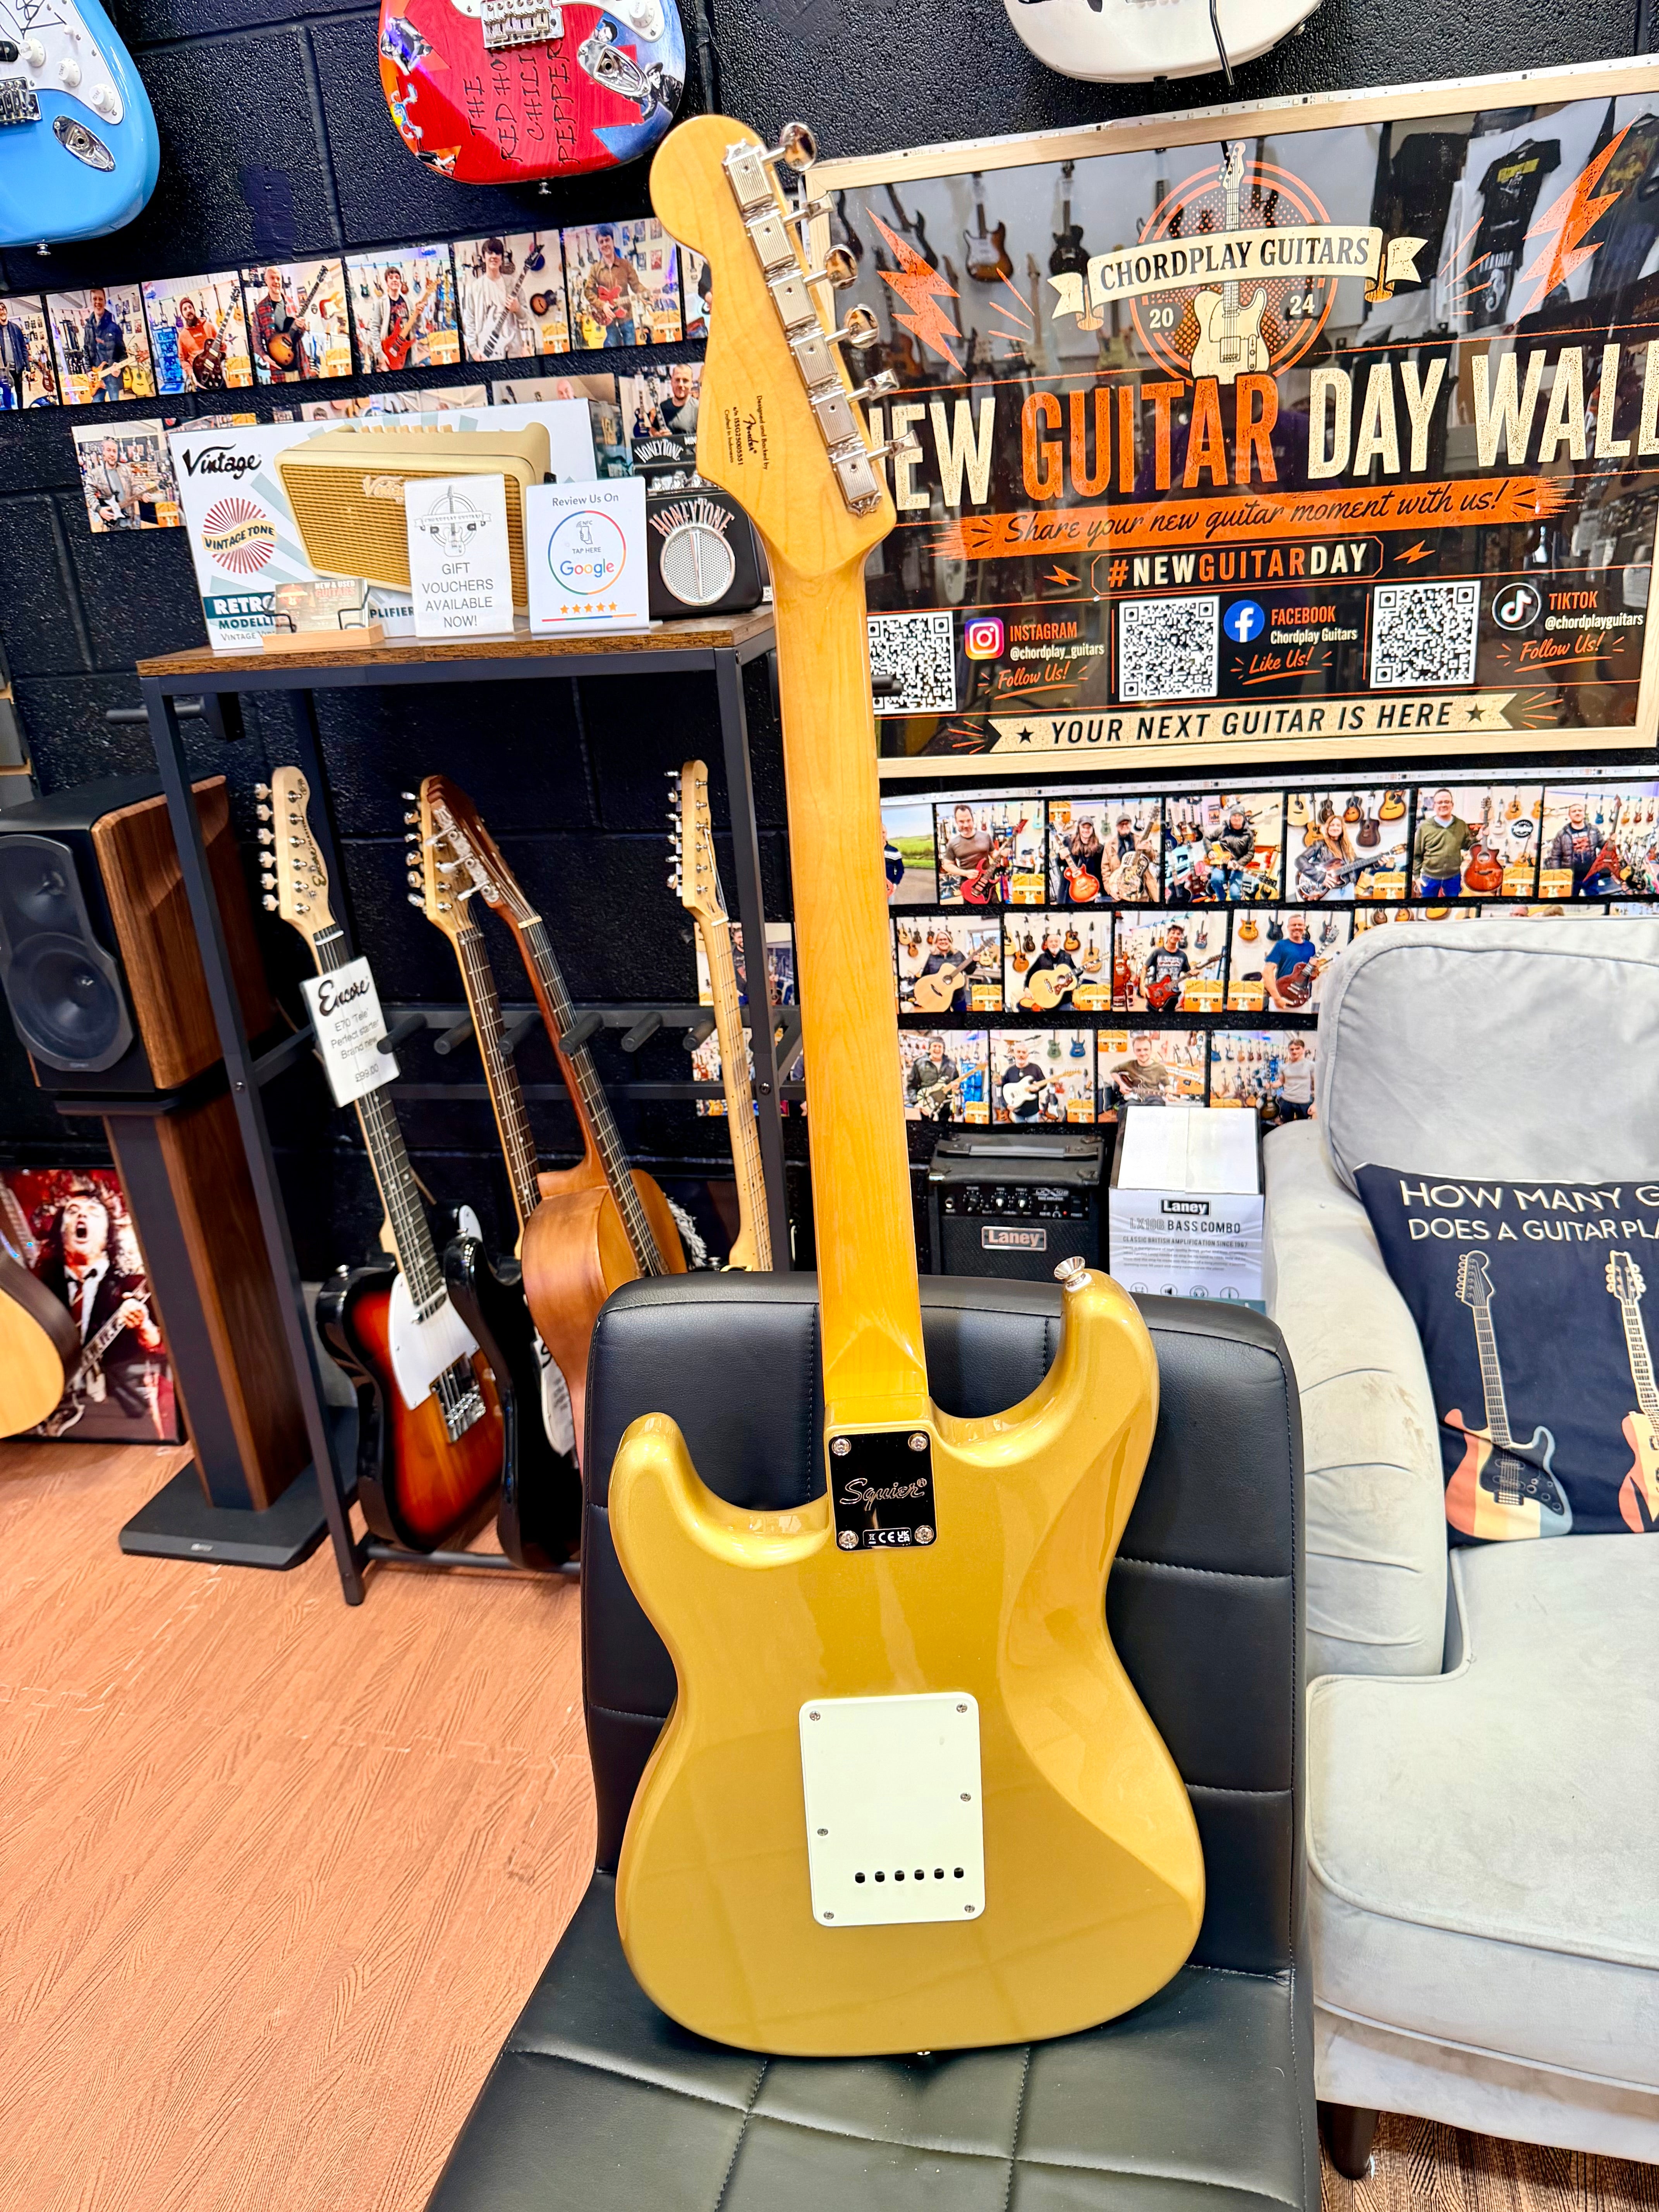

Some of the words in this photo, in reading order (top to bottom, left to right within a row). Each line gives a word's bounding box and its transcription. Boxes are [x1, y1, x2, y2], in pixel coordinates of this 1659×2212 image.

[489, 50, 511, 96] HO
[463, 76, 487, 136] THE
[518, 54, 544, 141] CHILI
[546, 41, 581, 165] PEPPER
[495, 103, 523, 162] RED
[1100, 241, 1251, 292] CHORDPLAY
[1259, 237, 1370, 267] GUITARS
[1149, 308, 1174, 329] 20
[1290, 295, 1315, 316] 24
[756, 395, 765, 424] Designed
[1021, 373, 1279, 501] GUITAR
[1307, 358, 1447, 480] DAY
[1471, 340, 1659, 467] WALL
[742, 413, 759, 452] Fender
[182, 443, 262, 480] Vintage
[634, 438, 684, 464] HONEYTONE
[684, 436, 697, 445] MIN
[761, 438, 769, 461] Backed
[763, 462, 770, 470] by
[552, 496, 587, 507] Review
[589, 494, 601, 503] Us
[603, 493, 619, 502] On
[649, 497, 735, 538] HONEYTONE
[1004, 512, 1082, 543] Share
[1086, 516, 1146, 547] your
[1147, 512, 1199, 531] new
[1206, 500, 1285, 538] guitar
[1289, 489, 1391, 523] moment
[1396, 481, 1454, 516] with
[1462, 479, 1511, 511] us!
[204, 529, 247, 550] VINTAGE
[248, 525, 275, 537] TONE
[441, 562, 470, 575] GIFT
[560, 558, 615, 578] Google
[1107, 543, 1367, 588] #NEWGUITARDAY
[315, 587, 356, 598] GUITARS
[422, 579, 494, 594] VOUCHERS
[426, 597, 493, 611] AVAILABLE
[1549, 591, 1598, 611] TIKTOK
[219, 616, 274, 630] MODELLI
[370, 606, 414, 619] PLIFIER
[444, 615, 477, 628] NOW!
[1271, 606, 1336, 626] FACEBOOK
[1544, 613, 1644, 632] @chordplayguitars
[220, 632, 257, 641] VINTAGE
[1010, 621, 1078, 642] INSTAGRAM
[1270, 630, 1320, 646] Chordplay
[1321, 629, 1358, 643] Guitars
[1010, 642, 1105, 661] @chordplay_guitars
[1519, 638, 1570, 662] Follow
[1574, 631, 1606, 655] Us!
[1249, 654, 1281, 675] Like
[1286, 646, 1315, 668] Us!
[998, 668, 1041, 689] Follow
[1045, 661, 1071, 682] Us!
[1051, 719, 1123, 745] YOUR
[1136, 713, 1209, 741] NEXT
[1221, 708, 1326, 737] GUITAR
[1338, 706, 1365, 731] IS
[1376, 702, 1453, 729] HERE
[318, 976, 370, 1017] Encore
[331, 1030, 359, 1049] Perfect
[359, 1018, 380, 1035] starter
[335, 1017, 351, 1032] E70
[341, 1045, 364, 1060] Brand
[364, 1036, 378, 1050] new
[355, 1063, 379, 1083] £99.00
[1163, 1199, 1207, 1215] Laney
[1399, 1179, 1502, 1210] HOW
[1512, 1187, 1622, 1213] MANY
[1130, 1218, 1164, 1230] LX10B
[1168, 1221, 1198, 1232] BASS
[1200, 1221, 1240, 1234] COMBO
[1408, 1218, 1491, 1240] DOES
[1497, 1222, 1520, 1240] A
[1522, 1219, 1619, 1242] GUITAR
[988, 1230, 1040, 1248] Laney
[1171, 1238, 1215, 1246] AMPLIFICATION
